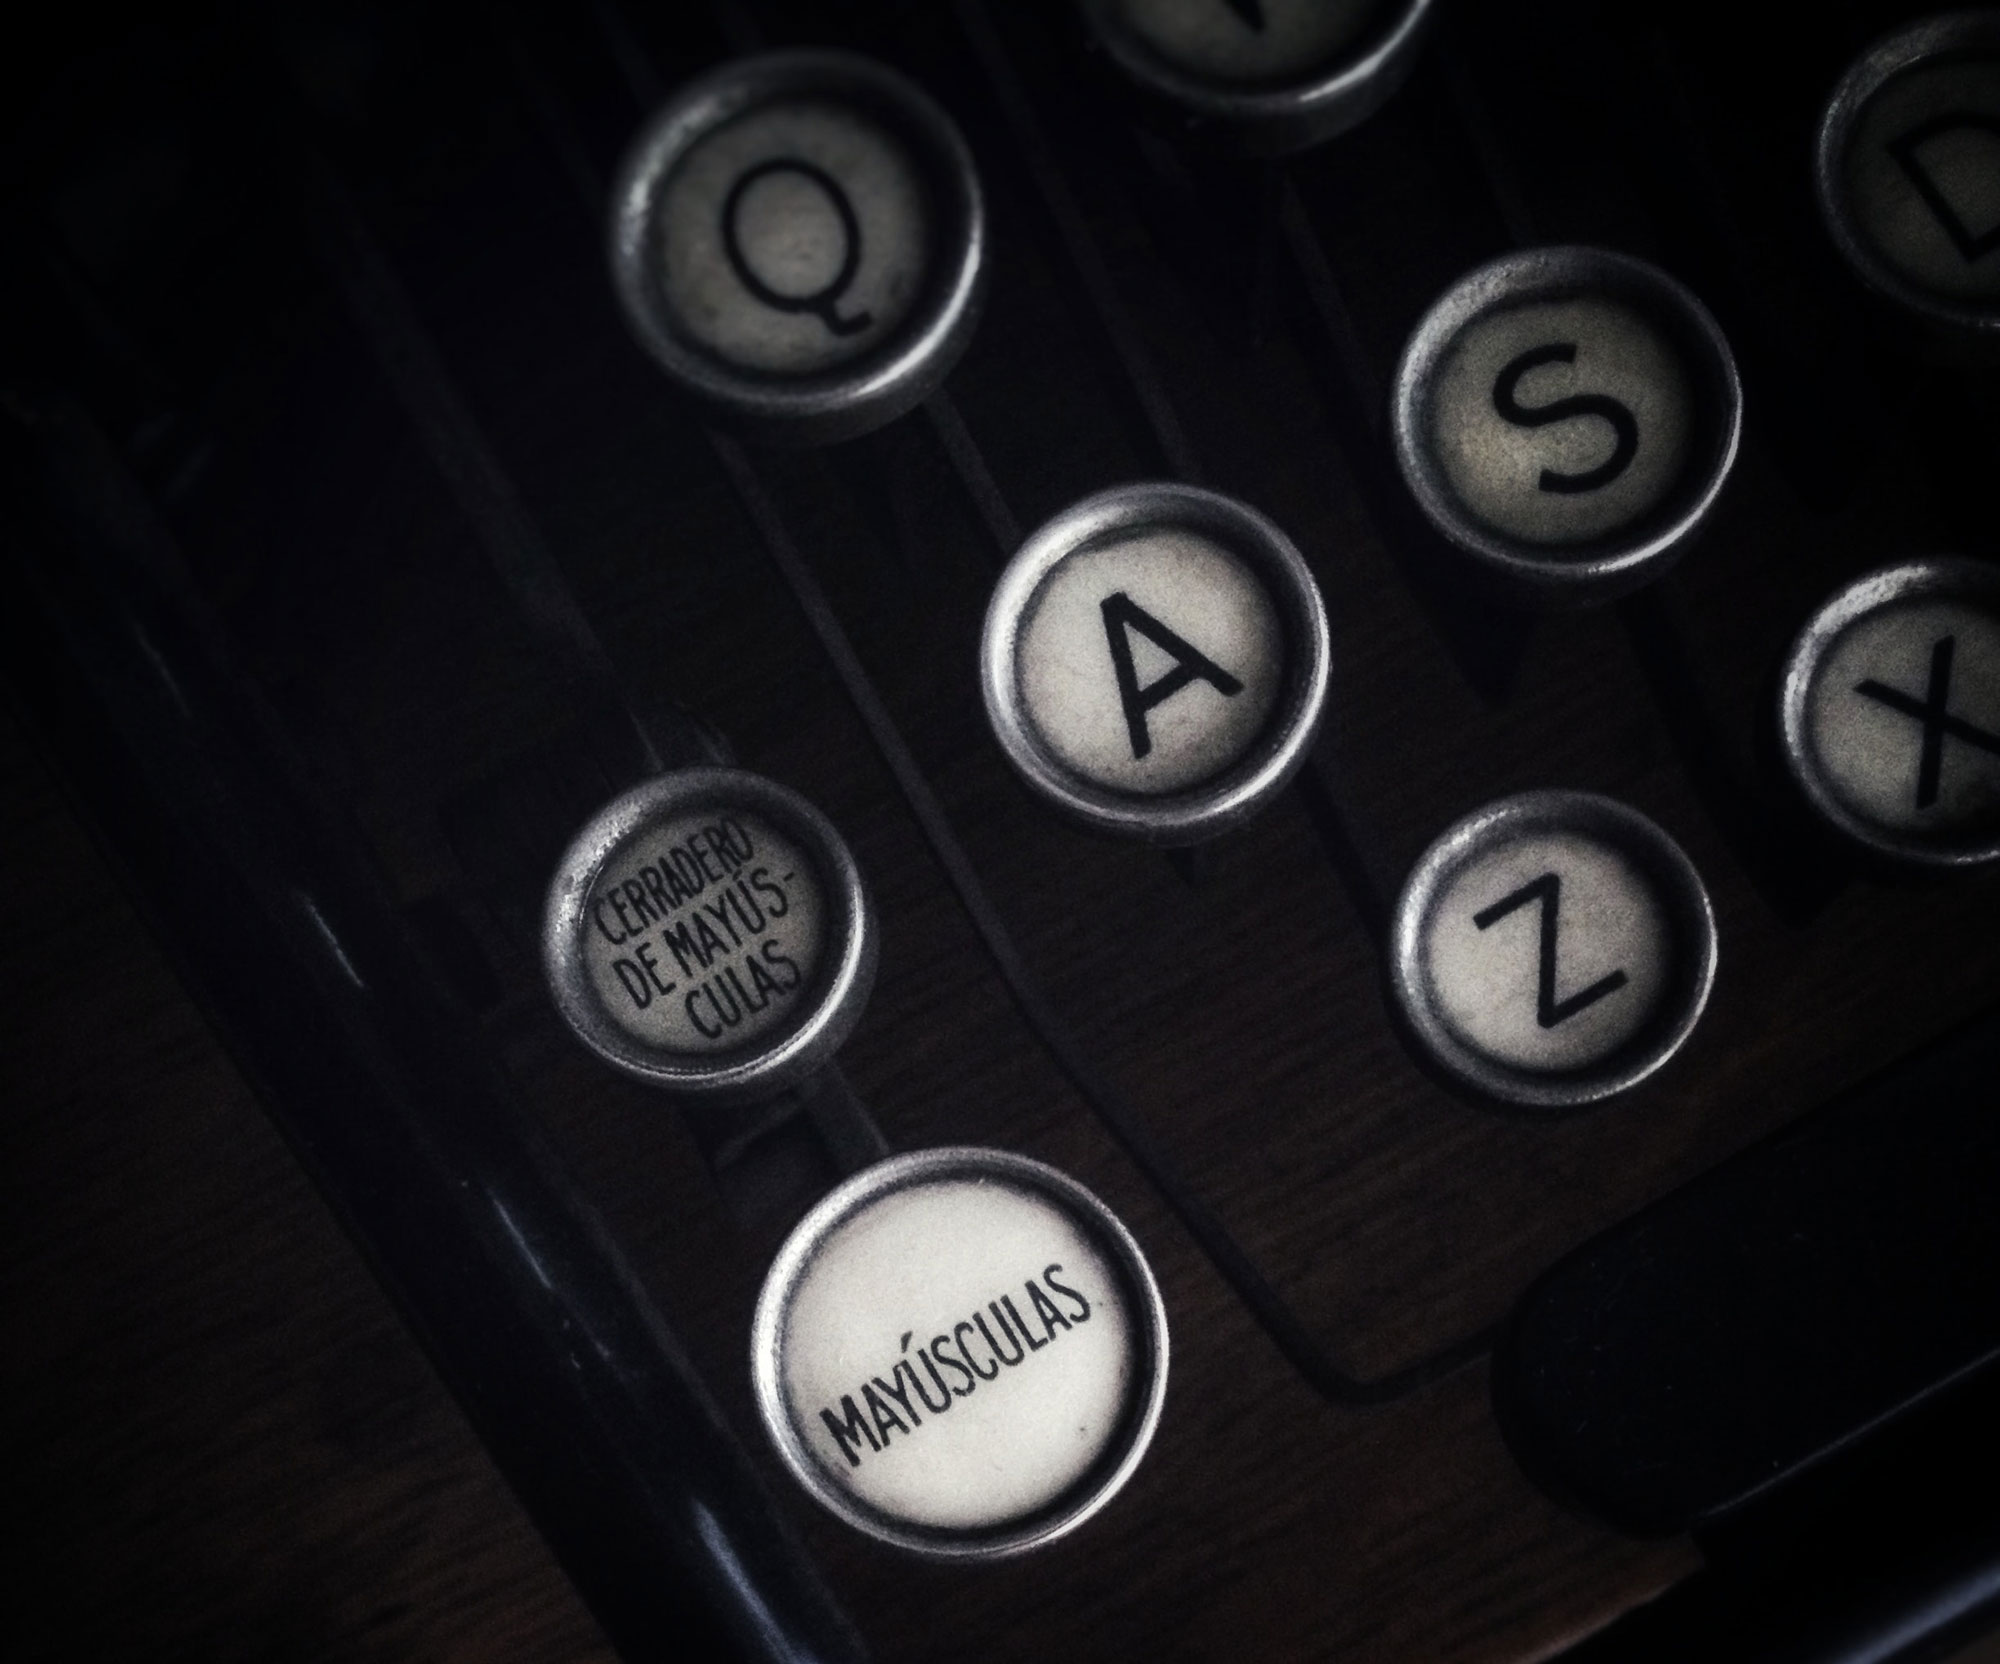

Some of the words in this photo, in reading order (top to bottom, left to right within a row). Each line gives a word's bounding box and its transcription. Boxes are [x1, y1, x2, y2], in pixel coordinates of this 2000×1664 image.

[722, 159, 872, 335] Q
[1493, 343, 1638, 493] S
[1100, 592, 1244, 759] A
[1853, 635, 2000, 809] X
[595, 818, 753, 945] CERRADERO
[613, 942, 675, 1009] DE
[663, 867, 794, 977] MAYÚS-
[1474, 872, 1628, 1028] Z
[685, 940, 798, 1038] CULAS
[820, 1264, 1090, 1466] MAYÚSCULAS
